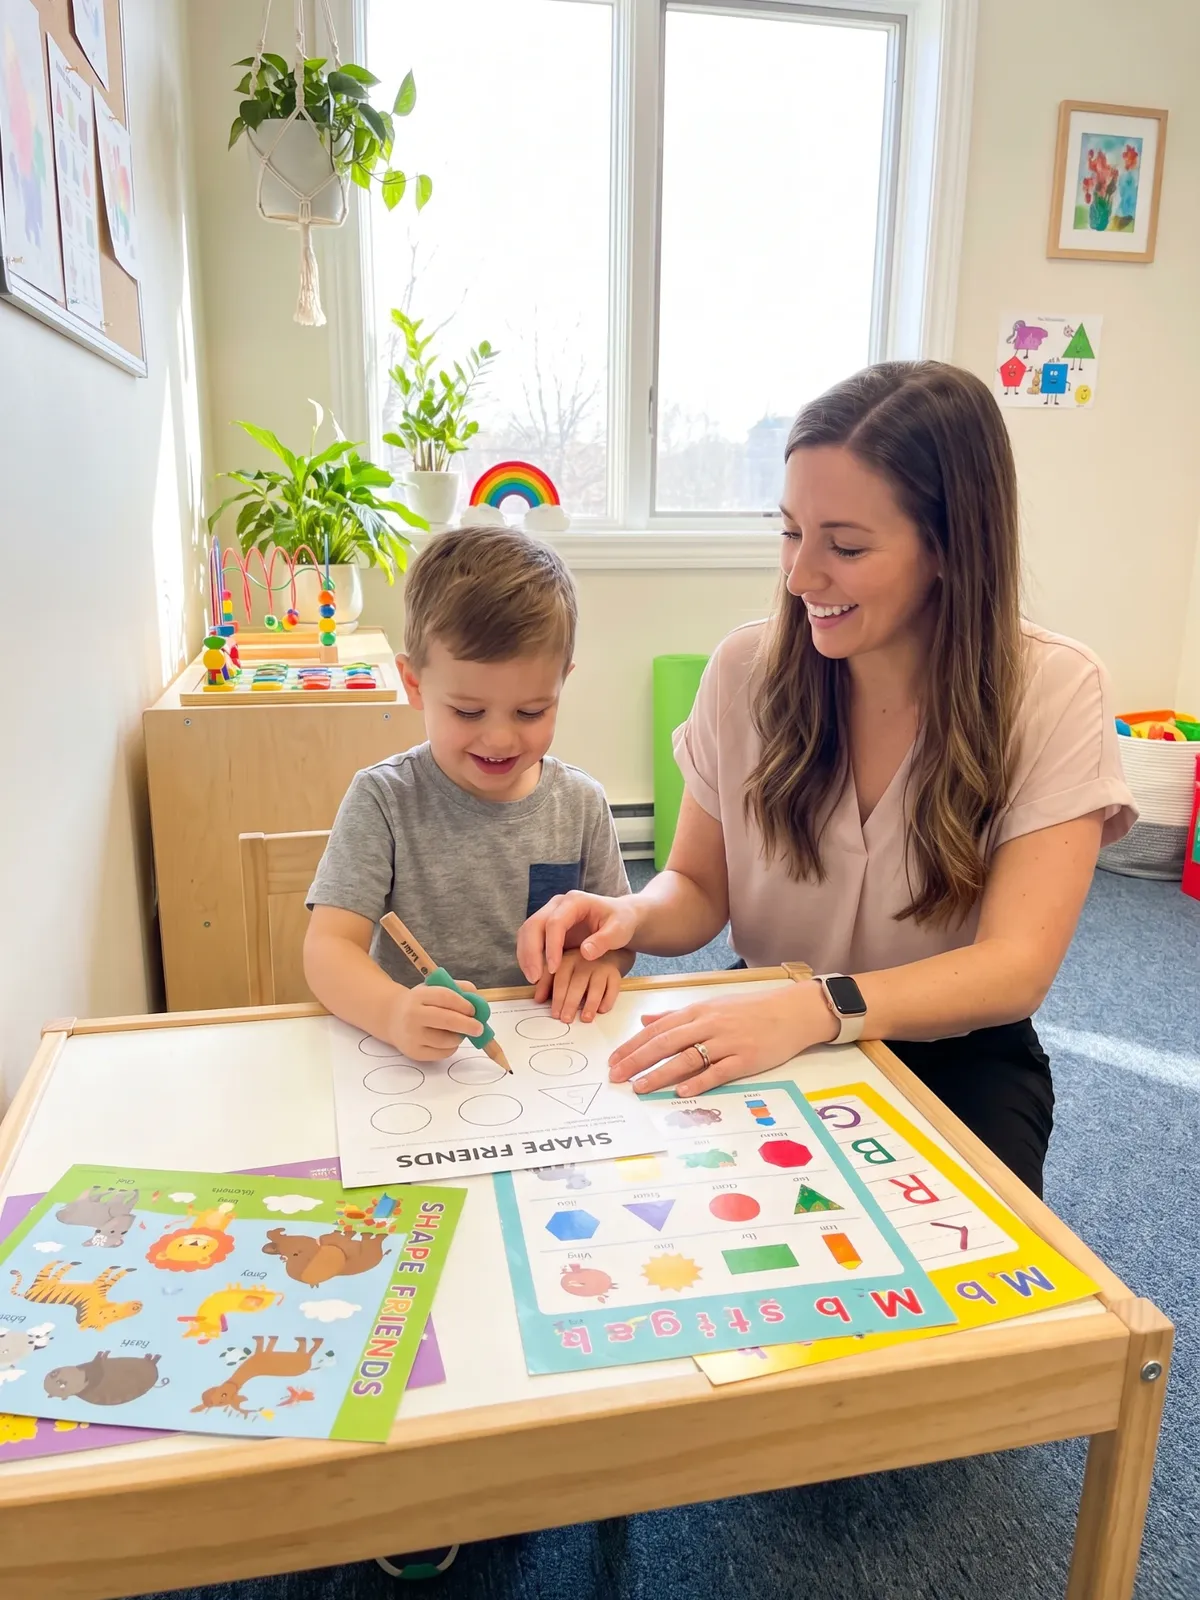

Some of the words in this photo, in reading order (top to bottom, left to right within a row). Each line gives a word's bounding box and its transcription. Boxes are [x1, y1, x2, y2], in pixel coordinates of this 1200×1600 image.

[396, 1143, 513, 1168] FRIENDS
[522, 1132, 613, 1155] SHAPE
[851, 1138, 897, 1165] B
[889, 1174, 940, 1205] R
[398, 1202, 445, 1274] SHAPE
[956, 1281, 997, 1305] b
[1000, 1265, 1055, 1297] M
[815, 1296, 852, 1322] b
[869, 1286, 925, 1318] M
[352, 1285, 417, 1397] FRIENDS
